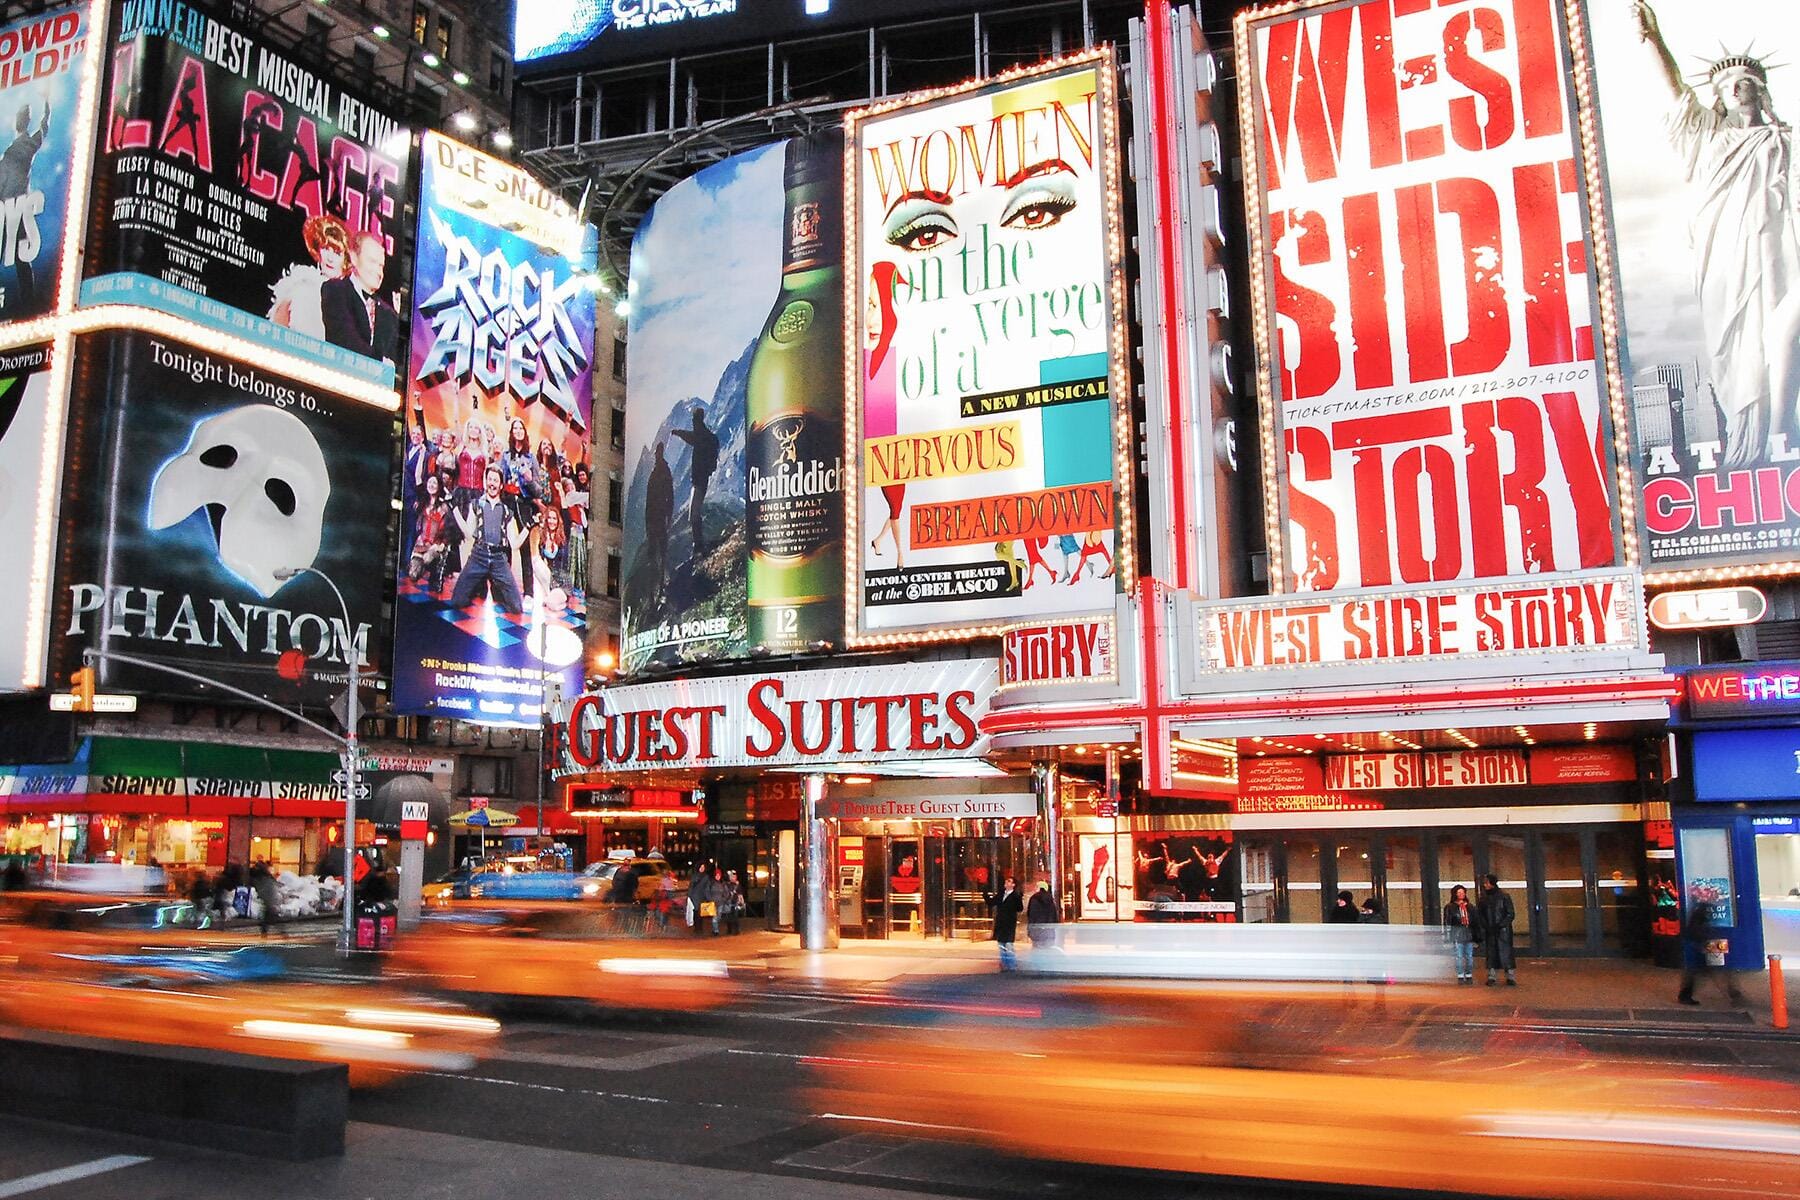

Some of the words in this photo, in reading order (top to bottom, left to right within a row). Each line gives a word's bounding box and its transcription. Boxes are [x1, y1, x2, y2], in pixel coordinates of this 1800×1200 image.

[613, 13, 646, 30] THE
[648, 6, 686, 25] NEW
[121, 0, 205, 41] WINNER!
[204, 17, 253, 79] BEST
[257, 47, 332, 124] MUSICAL
[1260, 0, 1566, 190] WEST
[105, 44, 213, 174] LA
[237, 90, 400, 256] CAGE
[863, 91, 1097, 212] WOMEN
[112, 204, 136, 221] JERRY
[140, 207, 178, 231] HERMAN
[117, 155, 150, 175] KELSEY
[153, 159, 195, 190] GRAMMER
[208, 182, 243, 211] DOUGLAS
[244, 199, 269, 223] HODGE
[136, 176, 150, 197] LA
[155, 180, 181, 207] CAGE
[183, 193, 203, 217] AUX
[207, 202, 242, 233] FOLLES
[195, 225, 226, 250] HARVEY
[227, 239, 265, 267] FIERSTEIN
[891, 254, 949, 307] on
[955, 222, 1034, 297] the
[418, 207, 588, 372] ROCK
[1266, 157, 1596, 402] SIDE
[971, 279, 1103, 360] verge
[149, 341, 224, 386] Tonight
[228, 365, 296, 409] belongs
[299, 388, 334, 418] to...
[901, 326, 948, 402] of
[956, 343, 984, 394] a
[961, 402, 975, 416] A
[980, 396, 1019, 413] NEW
[1025, 382, 1109, 407] MUSICAL
[1286, 385, 1457, 422] TICKETMASTER.COM
[748, 456, 844, 502] Glenfiddich
[870, 426, 1016, 484] NERVOUS
[760, 502, 792, 513] SINGLE
[795, 498, 822, 509] MALT
[789, 508, 829, 520] WHISKY
[914, 485, 1113, 544] BREAKDOWN
[1283, 391, 1615, 592] STORY
[864, 573, 909, 588] LINCOLN
[910, 570, 952, 583] CENTER
[953, 565, 1006, 579] THEATER
[871, 588, 885, 601] at
[886, 587, 903, 600] the
[920, 578, 999, 598] BELASCO
[65, 583, 373, 667] PHANTOM
[657, 623, 671, 643] OF
[671, 624, 681, 640] A
[681, 616, 730, 638] PIONEER
[776, 608, 798, 634] 12
[1218, 604, 1331, 668] WEST
[1342, 597, 1460, 660] SIDE
[1475, 582, 1614, 654] STORY
[1005, 622, 1099, 682] STORY
[568, 694, 727, 769] GUEST
[745, 678, 981, 758] SUITES
[21, 775, 77, 795] sbarro
[100, 772, 177, 796] sbarro
[194, 776, 263, 798] sbarro
[278, 780, 340, 802] sbarro
[1326, 753, 1388, 789] WEST
[1393, 752, 1454, 787] SIDE
[1460, 749, 1528, 785] STORY
